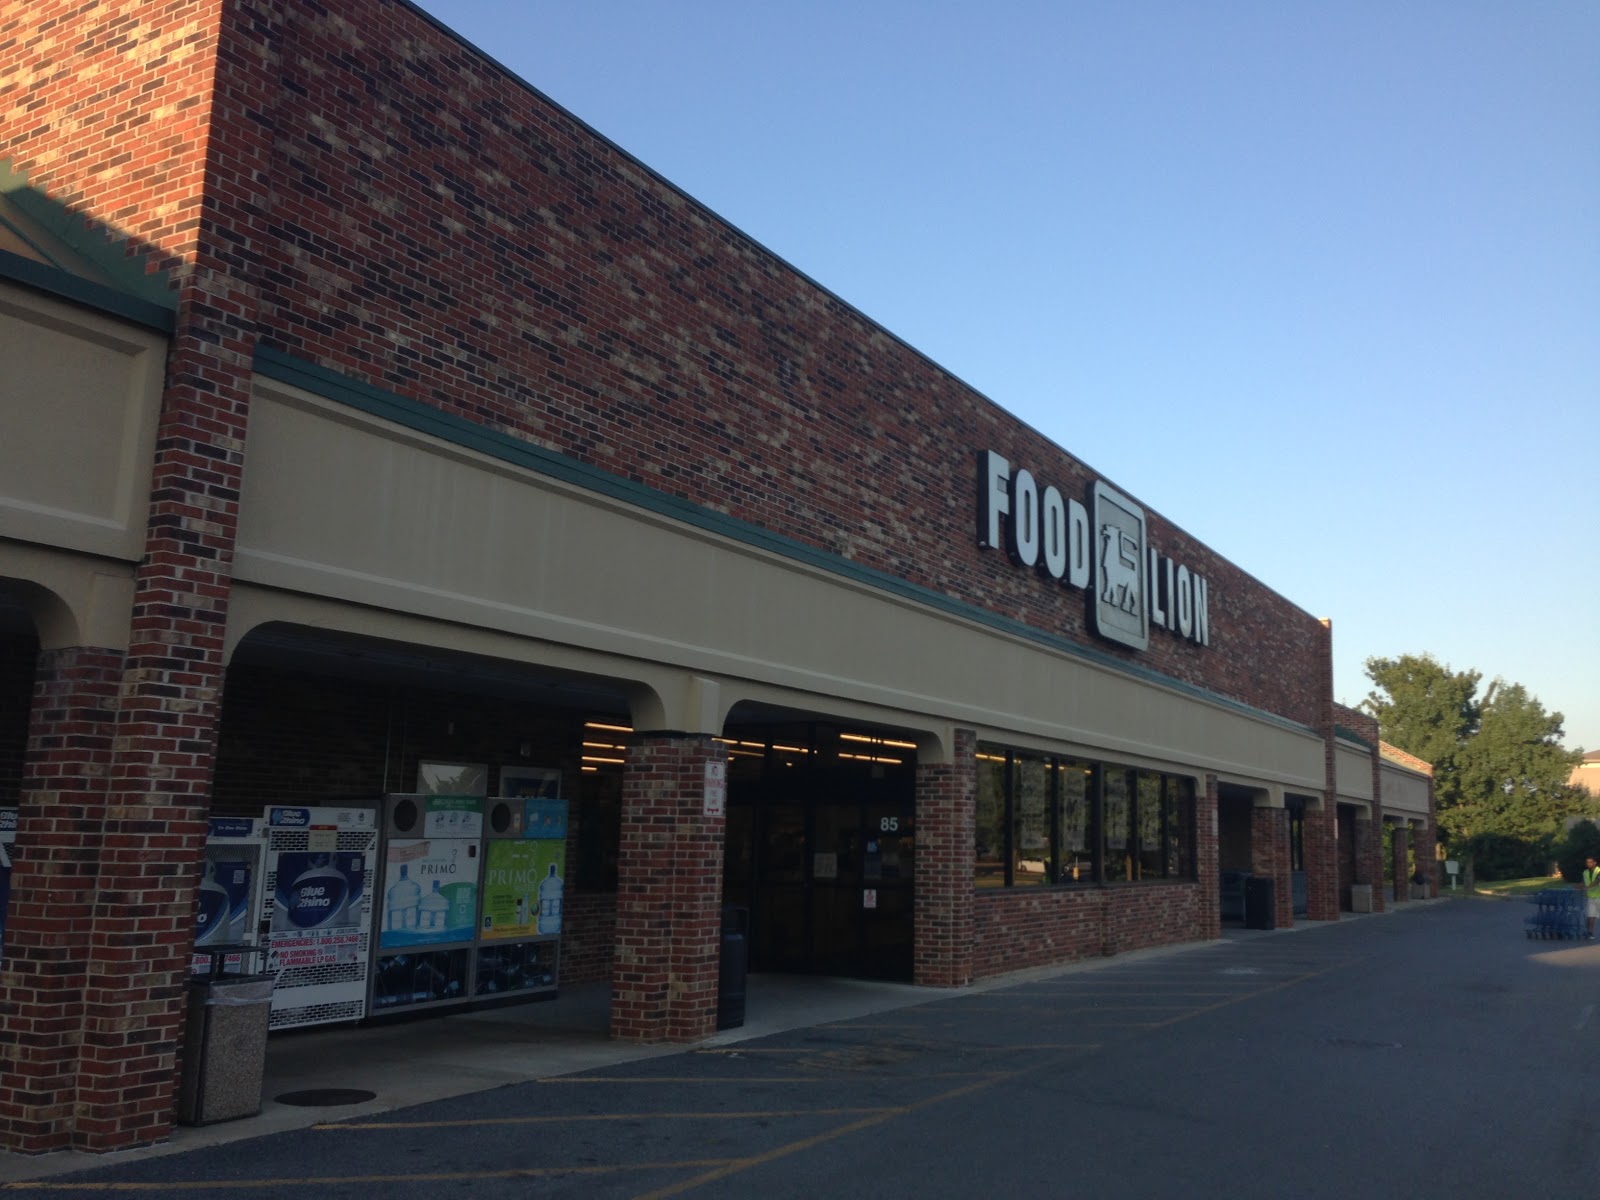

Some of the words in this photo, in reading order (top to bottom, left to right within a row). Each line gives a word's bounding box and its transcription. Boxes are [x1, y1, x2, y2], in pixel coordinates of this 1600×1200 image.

[983, 449, 1091, 590] FOOD
[1150, 547, 1209, 647] LION
[0, 811, 18, 820] Blu
[282, 809, 302, 818] Blue
[279, 816, 305, 825] Rhino
[880, 816, 898, 832] 85
[420, 863, 457, 875] PRIMO
[489, 868, 538, 885] PRIMO
[300, 886, 326, 898] Blue
[296, 896, 331, 908] Rhino
[271, 937, 316, 949] EMERGENCIES:
[280, 951, 289, 959] NO
[289, 949, 317, 958] SMOKING
[279, 957, 316, 967] FLAMMABLE
[317, 956, 325, 964] LP
[324, 954, 337, 963] GAS
